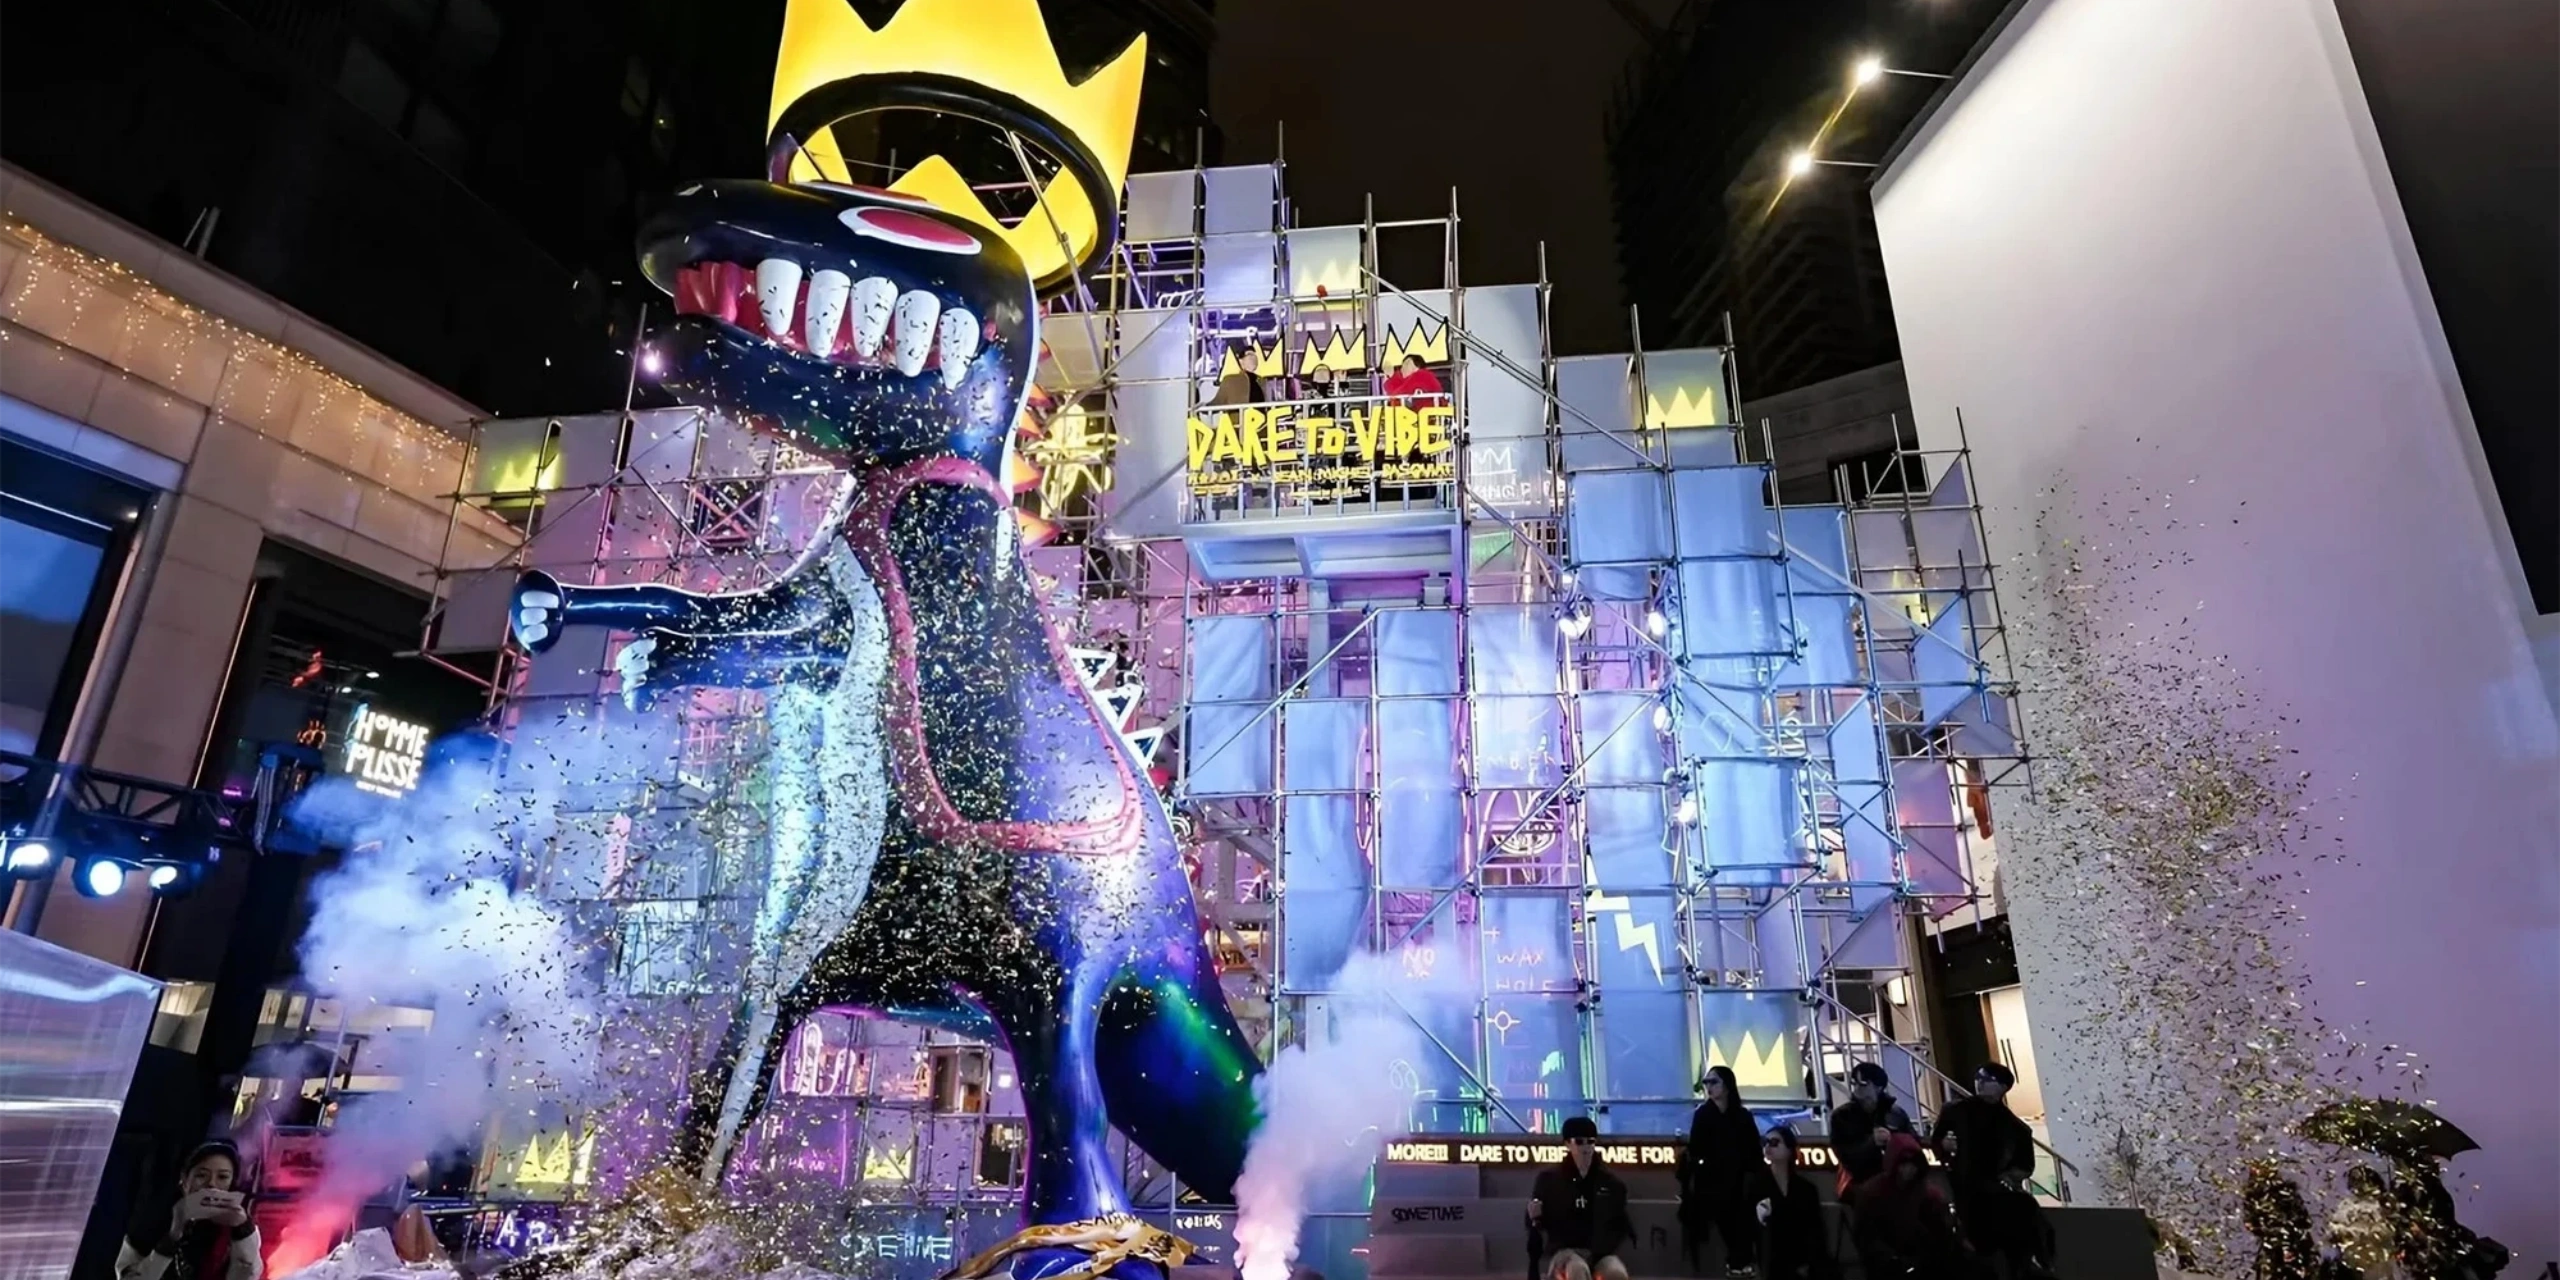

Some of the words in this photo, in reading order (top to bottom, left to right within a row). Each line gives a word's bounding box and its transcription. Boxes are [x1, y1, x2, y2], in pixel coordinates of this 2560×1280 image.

[1187, 405, 1297, 474] DARE
[1352, 405, 1453, 461] VIBE
[1460, 1144, 1503, 1162] DARE
[1505, 1146, 1529, 1163] TO
[1640, 1146, 1675, 1164] FOR
